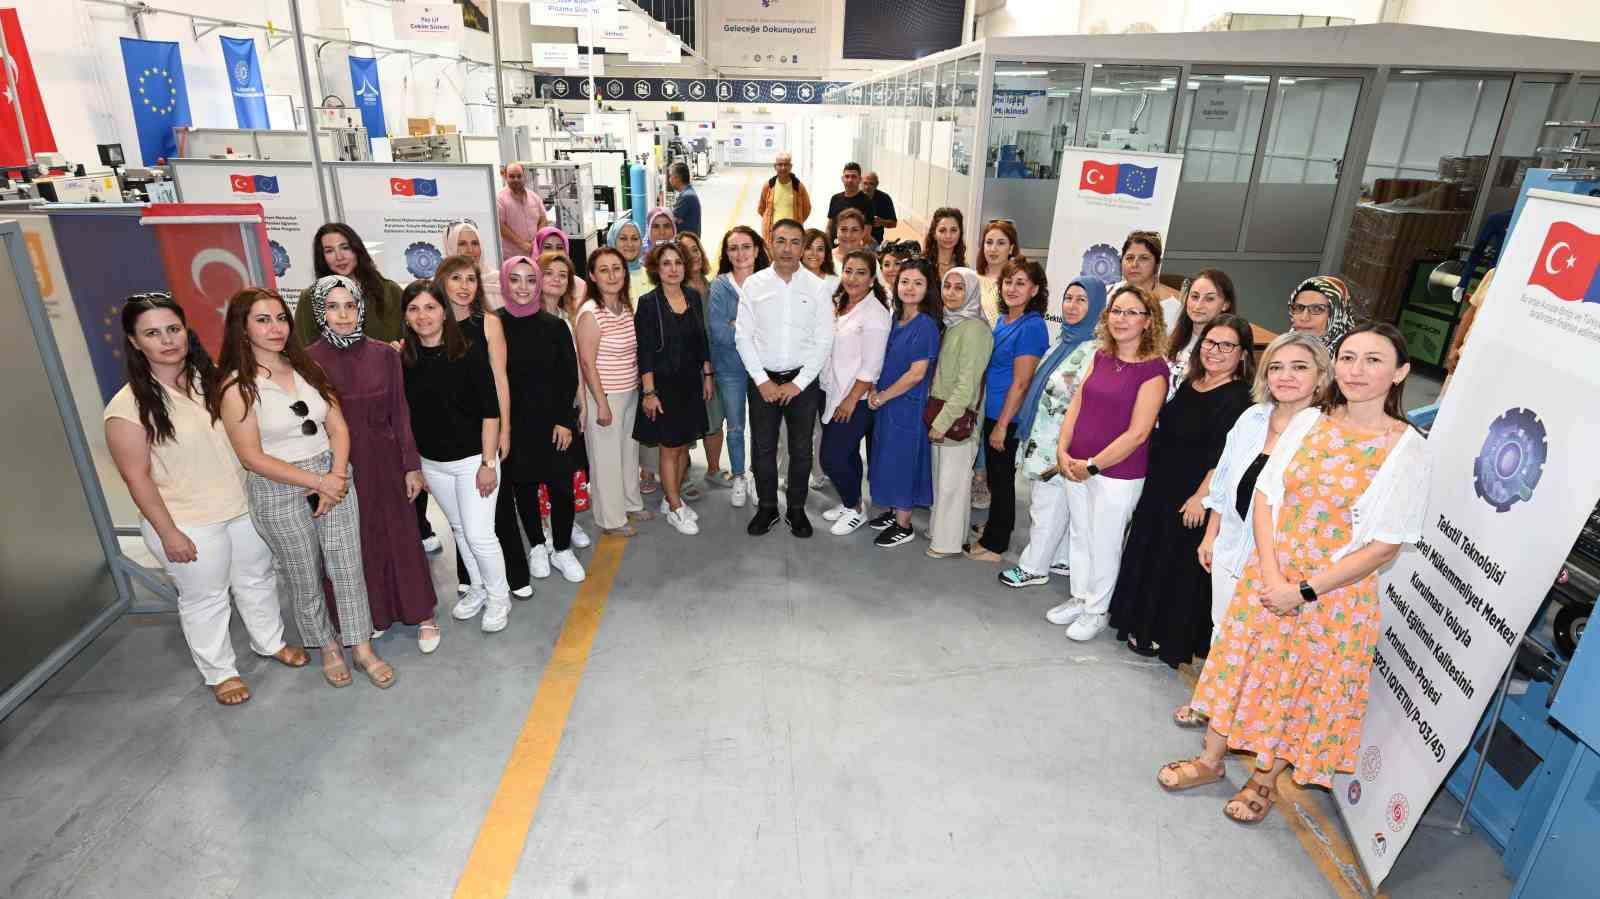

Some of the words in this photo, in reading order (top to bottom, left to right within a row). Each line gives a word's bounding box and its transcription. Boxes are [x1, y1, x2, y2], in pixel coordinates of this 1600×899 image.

[723, 24, 760, 34] Geleceğe
[1045, 313, 1063, 323] Sektö
[1436, 514, 1463, 544] Tekstil
[1459, 536, 1507, 586] Teknolojisi
[1410, 570, 1444, 617] Kurulması
[1442, 607, 1472, 648] Yoluyla
[1429, 550, 1484, 611] Mükemmeliyet
[1481, 603, 1519, 647] Merkezi
[1384, 625, 1418, 673] Artırılması
[1415, 664, 1442, 706] Projesi
[1385, 582, 1410, 617] Mesleki
[1406, 609, 1435, 650] Eğitimin
[1432, 643, 1475, 700] Kalitesinin
